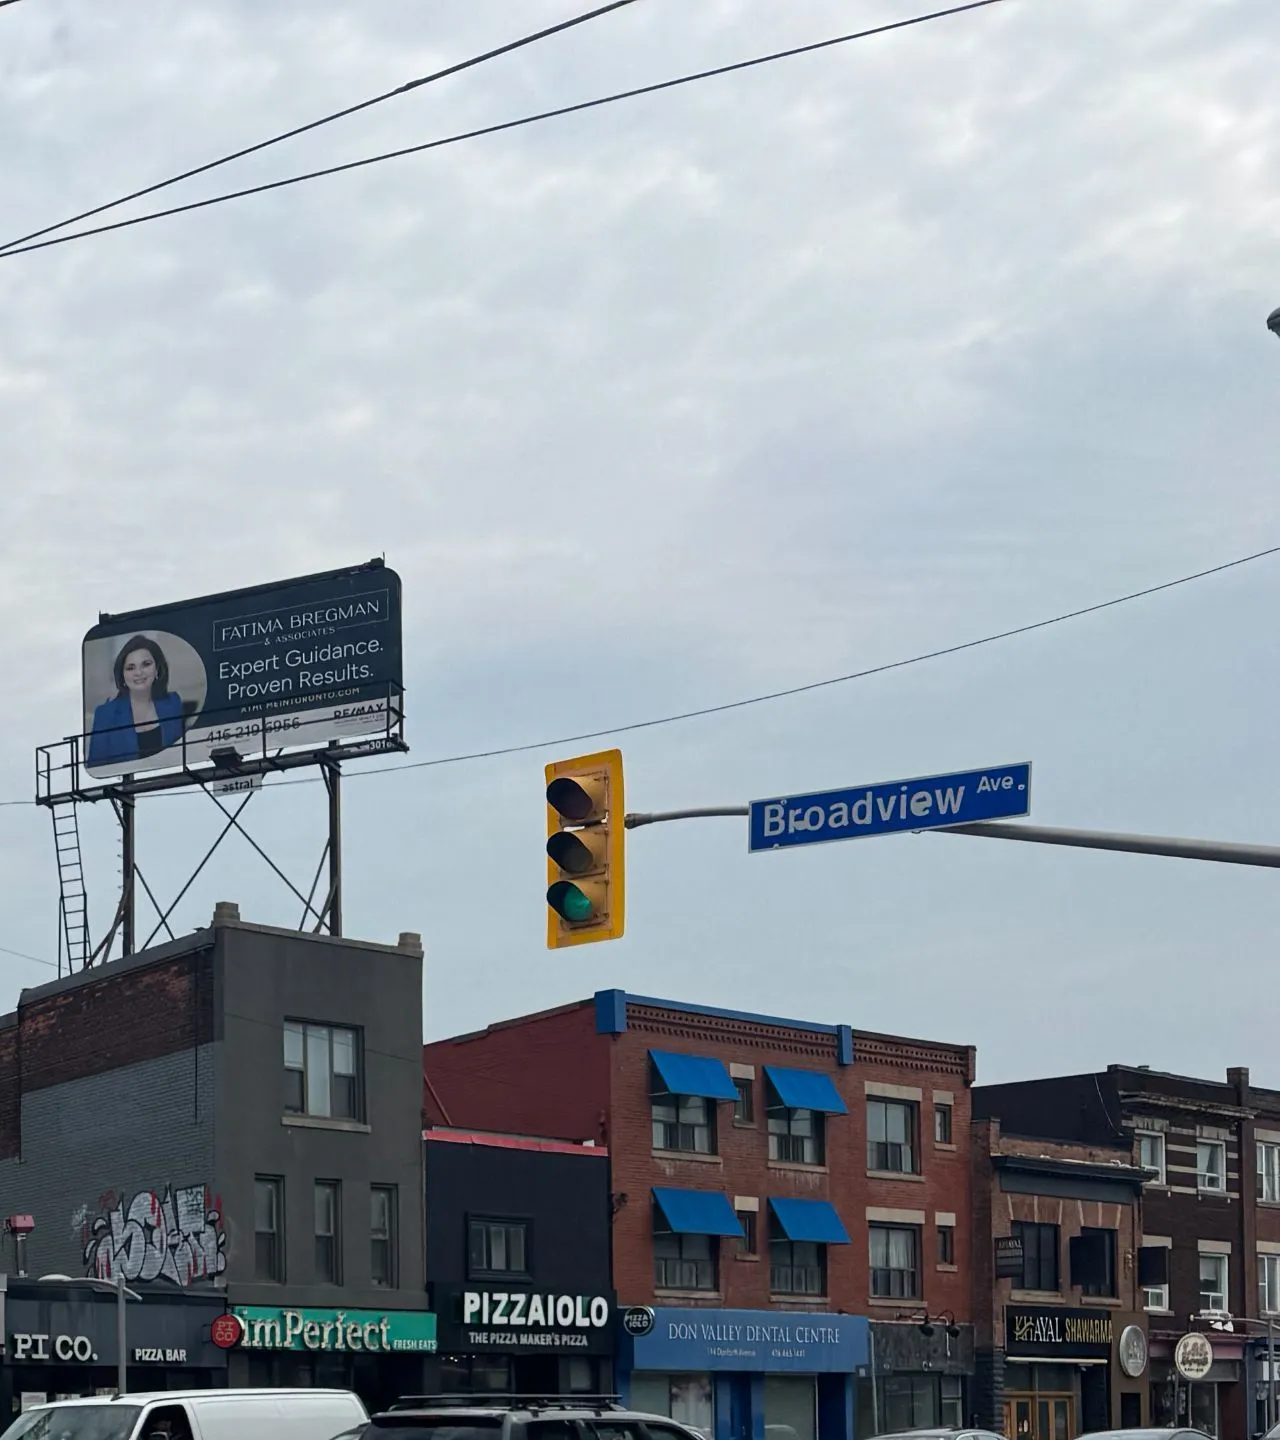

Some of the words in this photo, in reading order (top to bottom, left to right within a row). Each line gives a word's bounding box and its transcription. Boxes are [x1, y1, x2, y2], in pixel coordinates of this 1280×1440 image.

[222, 618, 283, 641] FATIMA
[290, 600, 380, 629] BREGMAN
[275, 626, 336, 644] ASSOCIATES
[219, 654, 280, 680] Expert
[285, 639, 384, 667] Guidance.
[228, 677, 292, 700] Proven
[299, 663, 374, 688] Results.
[222, 778, 255, 793] astral
[763, 784, 966, 838] Broadview
[463, 1291, 609, 1328] PIZZAIOLO
[624, 1314, 649, 1322] PIZZA
[240, 1309, 391, 1350] imPerfect
[468, 1332, 488, 1344] THE
[490, 1333, 518, 1345] PIZZA
[520, 1332, 560, 1346] MAKER'S
[561, 1334, 588, 1346] PIZZA
[669, 1323, 697, 1340] DON
[701, 1324, 741, 1341] VALLEY
[746, 1326, 791, 1343] DENTAL
[795, 1327, 840, 1344] CENTRE
[1014, 1315, 1062, 1343] KHAYAL
[1065, 1317, 1113, 1344] SHAWARMA
[14, 1333, 49, 1359] PI
[55, 1334, 98, 1361] CO.
[135, 1349, 164, 1361] PIZZA
[165, 1349, 187, 1362] BAR
[393, 1339, 417, 1350] FRESH
[418, 1340, 438, 1350] EATS
